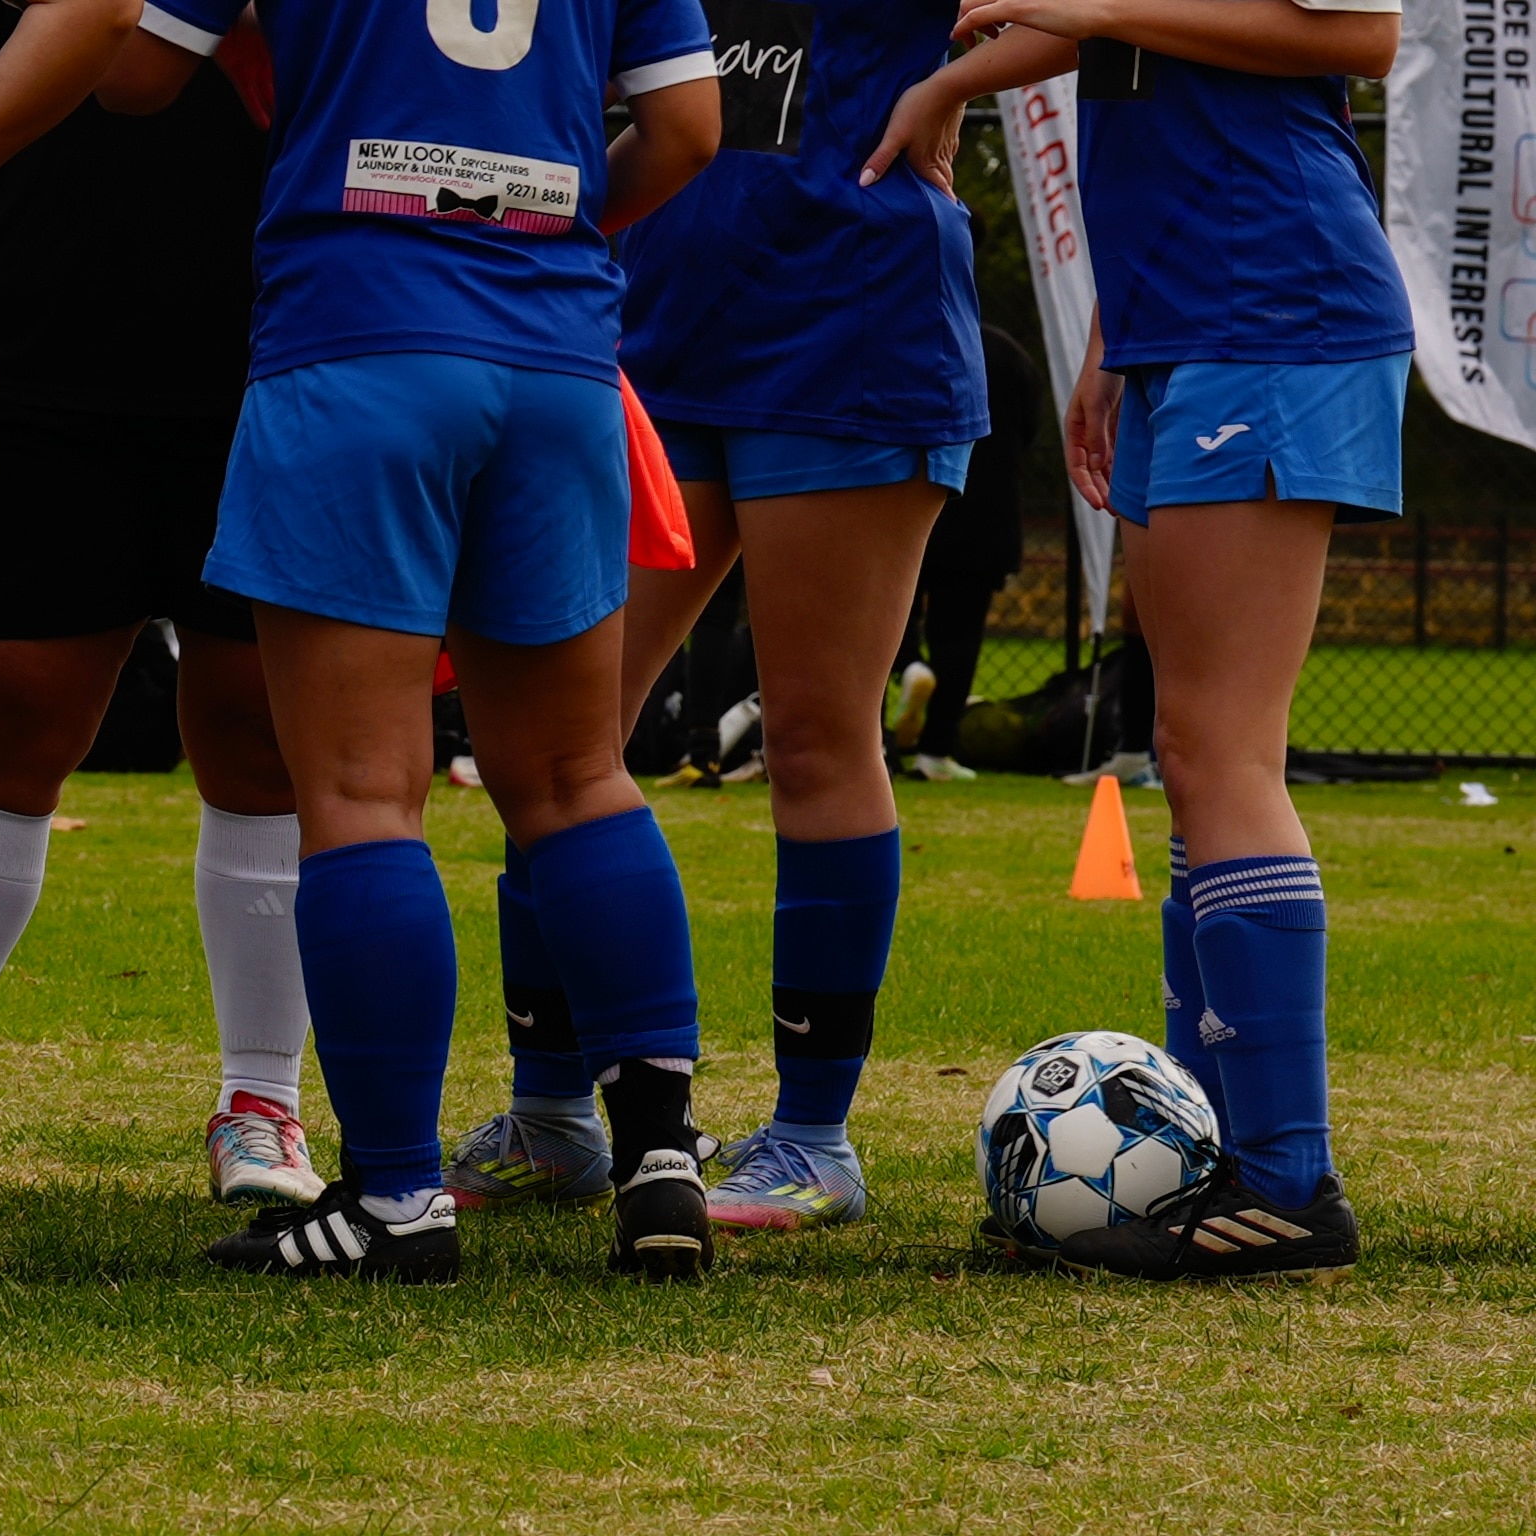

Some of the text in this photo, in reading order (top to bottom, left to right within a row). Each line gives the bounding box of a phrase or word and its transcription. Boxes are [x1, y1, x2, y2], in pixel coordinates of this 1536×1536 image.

[1503, 49, 1530, 90] OF
[712, 34, 803, 145] ary
[356, 160, 495, 183] LAUNDRY & LINEN SERVICE
[359, 143, 399, 159] NEW
[404, 145, 457, 165] LOOK
[461, 157, 530, 177] DRYCLEANERS
[506, 182, 571, 206] 9271 8881
[1034, 139, 1077, 265] Rice
[1450, 206, 1491, 385] INTERESTS
[640, 1158, 689, 1174] adidas
